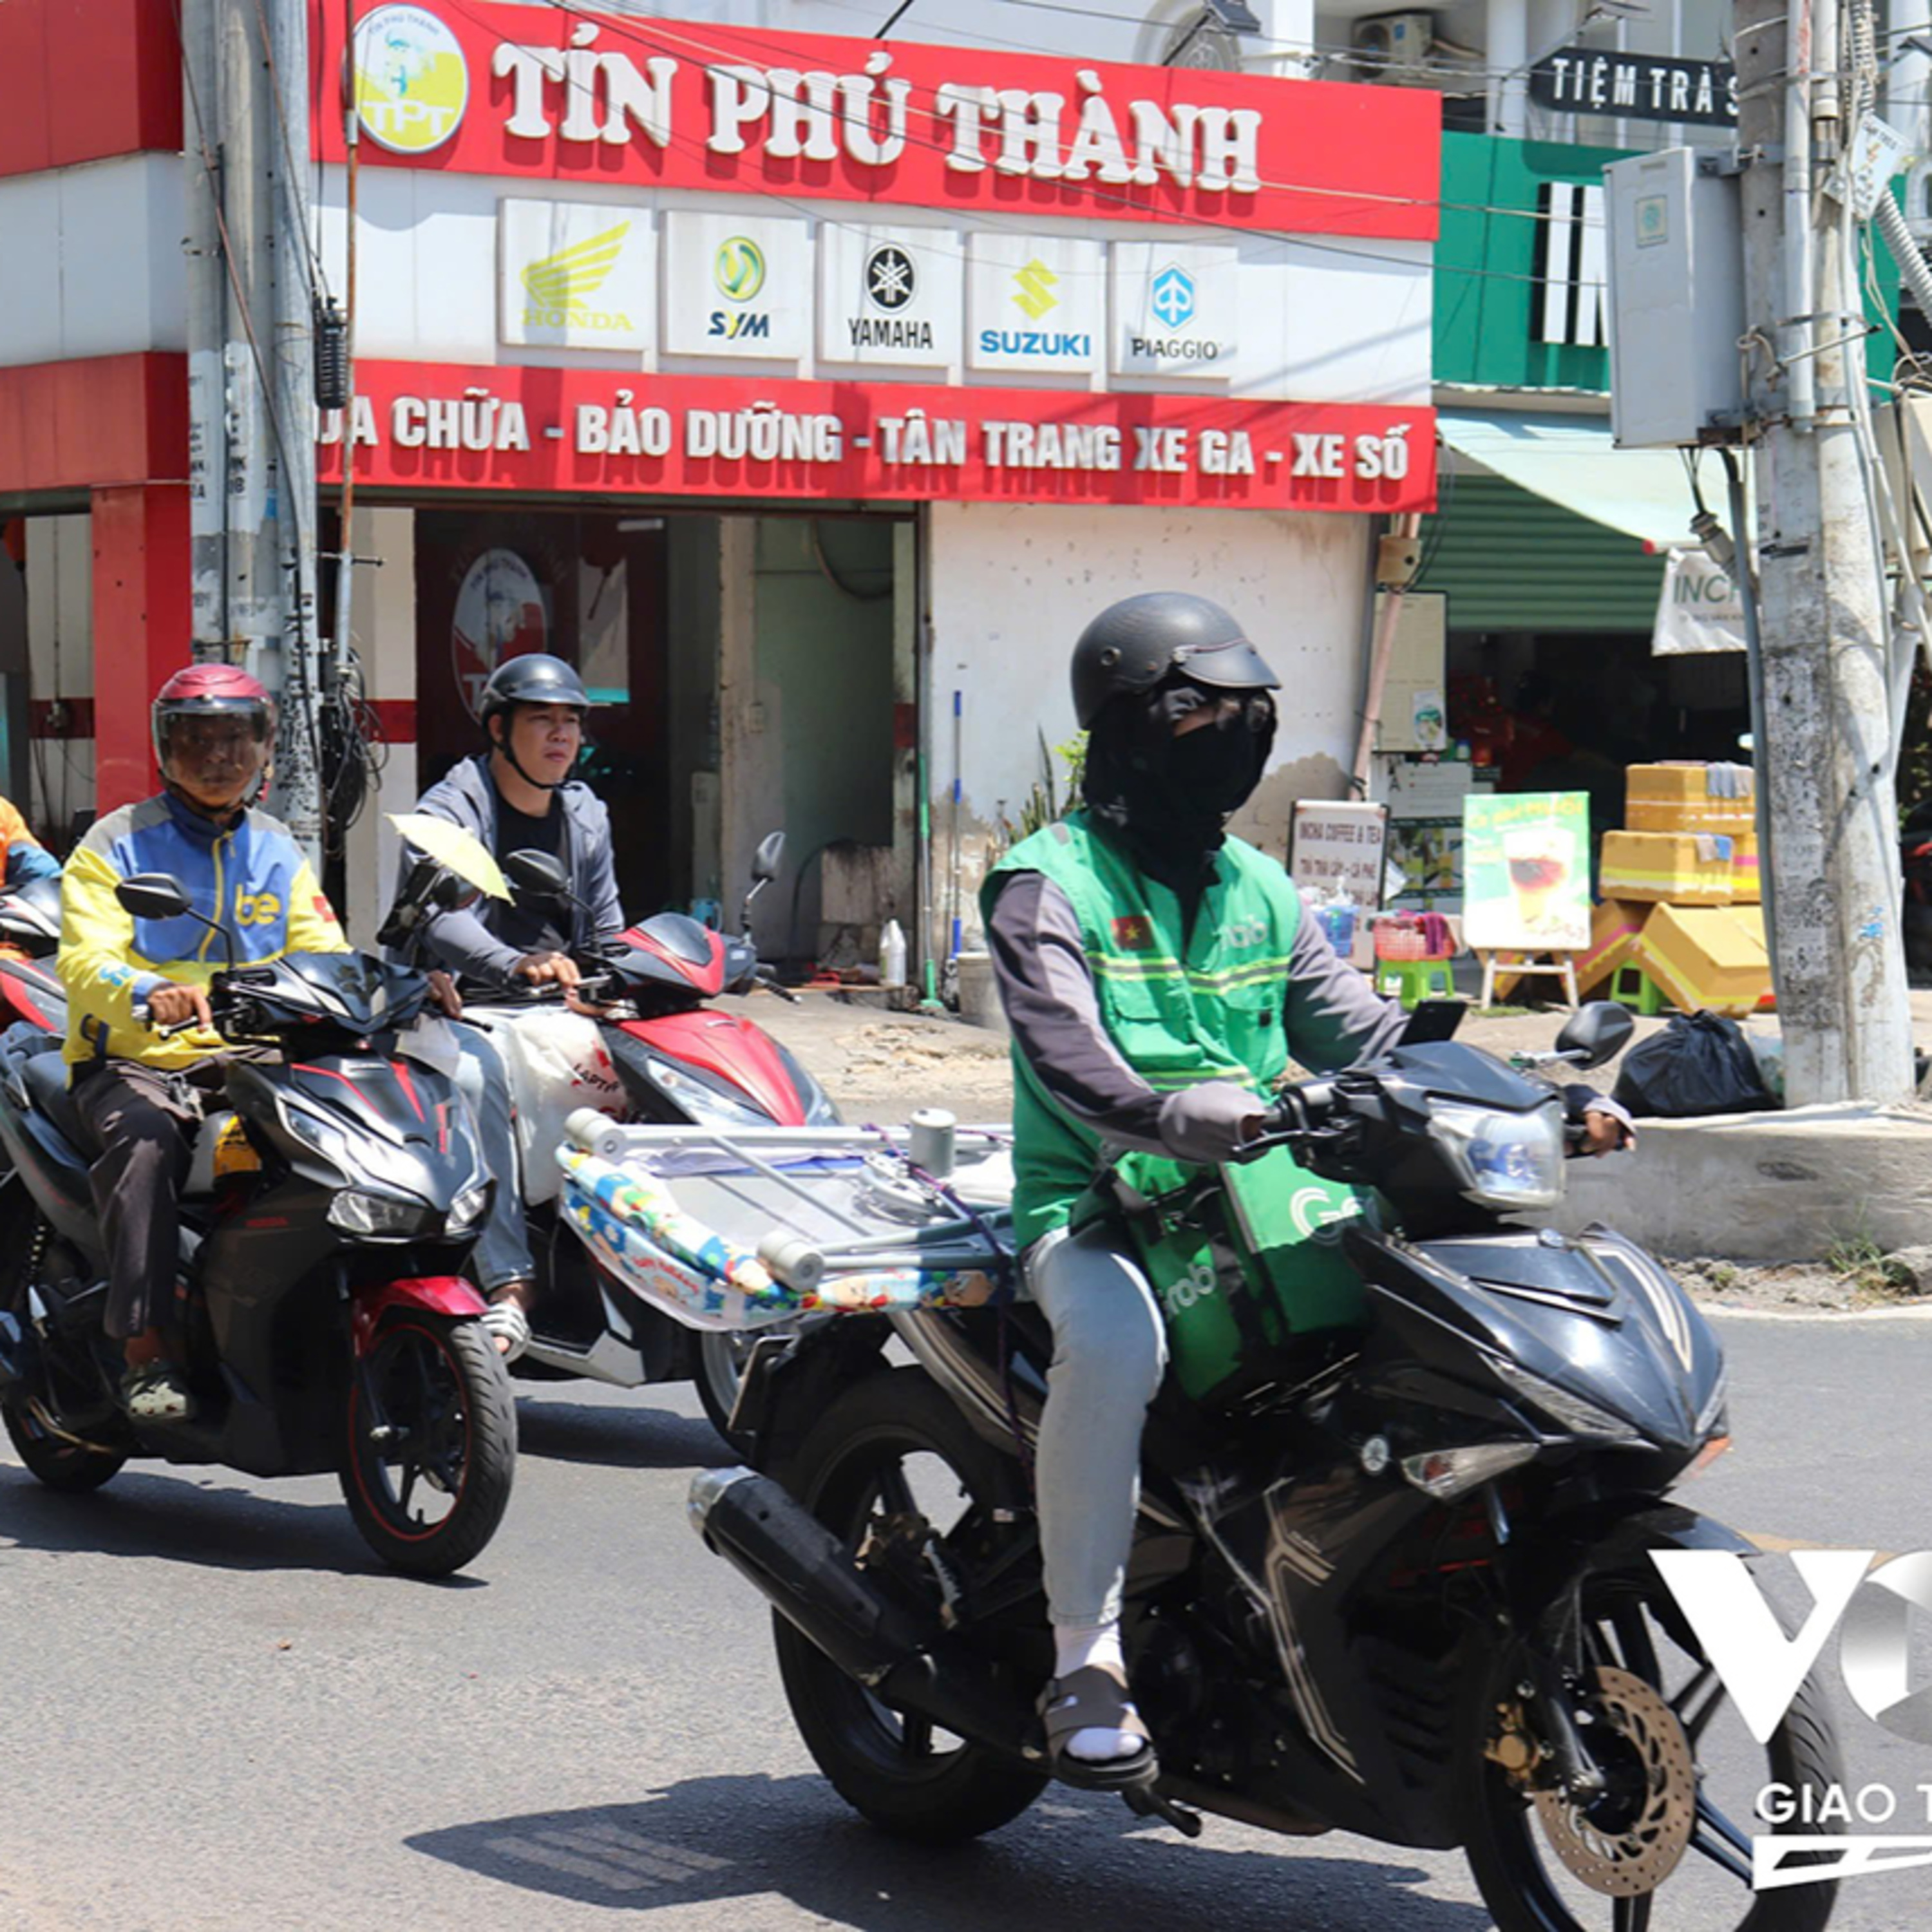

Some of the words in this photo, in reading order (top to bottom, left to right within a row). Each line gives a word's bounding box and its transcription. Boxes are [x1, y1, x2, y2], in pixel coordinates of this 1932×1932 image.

[1552, 56, 1636, 109] TIỆM
[1650, 66, 1712, 113] TRÀ
[363, 99, 455, 137] TPT
[491, 23, 678, 148] TÍN
[706, 51, 912, 166] PHÚ
[936, 69, 1262, 193] THÀNH
[522, 308, 634, 331] HONDA
[708, 311, 770, 339] SYM
[848, 317, 933, 349] YAMAHA
[980, 330, 1090, 356] SUZUKI
[1132, 338, 1218, 360] PIAGGIO
[392, 388, 529, 451] CHỮA
[576, 389, 672, 456] BẢO
[878, 408, 967, 465] TÂN
[981, 421, 1122, 470] TRANG
[1135, 426, 1188, 473] XE
[1198, 430, 1255, 475] GA
[1291, 432, 1345, 477] XE
[1355, 422, 1412, 480] SỐ
[235, 884, 281, 925] be
[1166, 1263, 1217, 1316] rab
